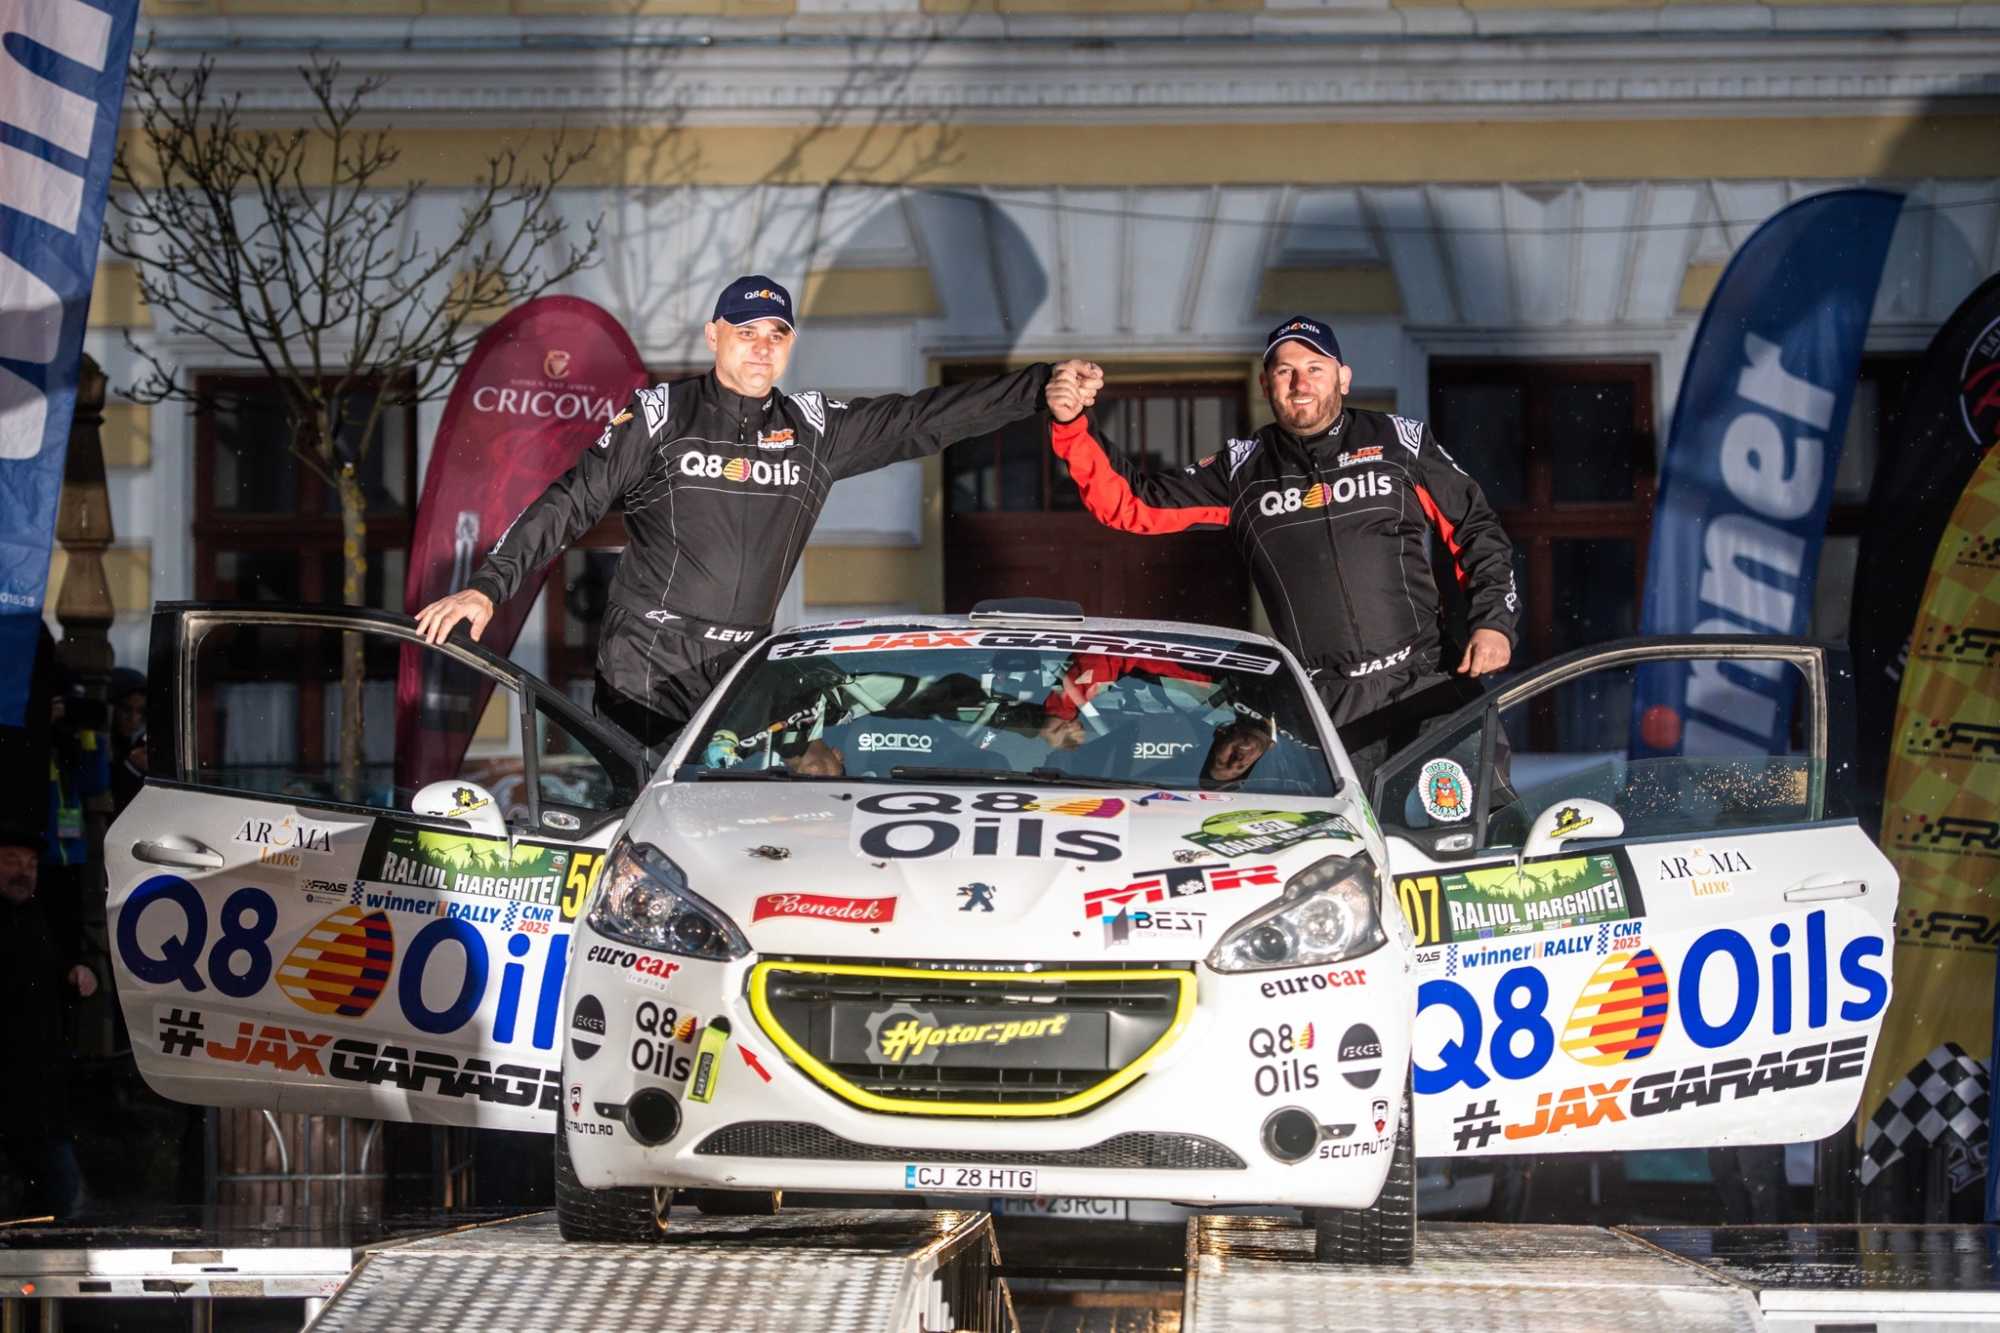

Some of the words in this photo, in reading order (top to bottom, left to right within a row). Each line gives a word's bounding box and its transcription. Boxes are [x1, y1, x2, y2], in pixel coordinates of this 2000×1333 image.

[473, 386, 615, 422] CRICOVA
[680, 451, 722, 478] Q8
[752, 459, 800, 485] Oils
[1259, 488, 1301, 516] Q8
[1332, 471, 1392, 503] Oils
[704, 627, 754, 642] LEVI
[1350, 645, 1411, 676] JAXY
[858, 733, 932, 750] sparco
[856, 791, 1038, 815] Q8
[860, 817, 1122, 862] Oils
[259, 846, 300, 870] Luxe
[311, 880, 347, 893] FRAS
[380, 851, 448, 890] RALIUL
[454, 871, 562, 907] HARGHITEI
[1084, 863, 1281, 919] MTR
[1691, 879, 1731, 896] Luxe
[366, 889, 436, 916] winner
[446, 902, 501, 925] RALLY
[521, 905, 554, 921] CNR
[767, 894, 883, 920] Benedek
[1449, 896, 1522, 932] RALIUL
[1523, 878, 1626, 922] HARGHITEI
[517, 919, 549, 935] 2025
[1135, 911, 1207, 938] BEST
[1461, 946, 1532, 969] winner
[1543, 935, 1594, 958] RALLY
[1612, 921, 1643, 938] CNR
[1611, 936, 1642, 951] 2025
[117, 873, 279, 998] Q8
[399, 917, 568, 1051] Oil
[587, 944, 680, 980] eurocar
[1260, 967, 1367, 999] eurocar
[635, 1001, 676, 1037] Q8
[1415, 966, 1557, 1095] Q8
[1677, 909, 1889, 1049] Oils
[1248, 1024, 1294, 1059] Q8
[631, 1038, 691, 1082] Oils
[1255, 1058, 1320, 1096] Oils
[1452, 1035, 1868, 1150] #JAXGARAGE
[918, 1168, 944, 1187] CJ
[956, 1167, 982, 1188] 28
[989, 1168, 1033, 1188] HTG
